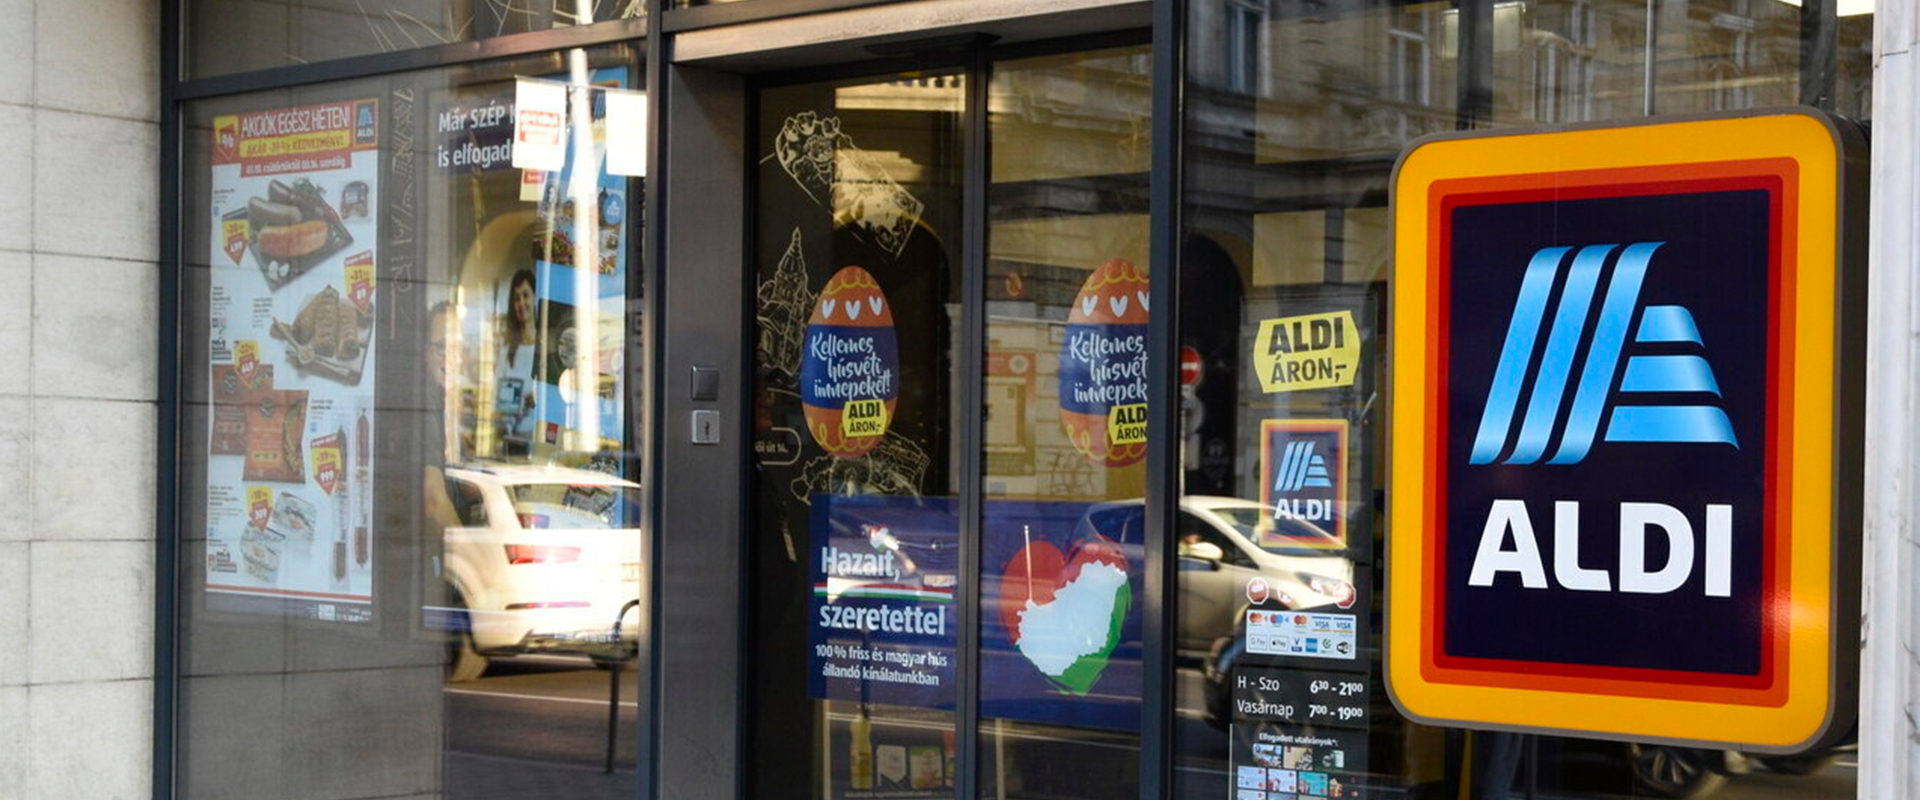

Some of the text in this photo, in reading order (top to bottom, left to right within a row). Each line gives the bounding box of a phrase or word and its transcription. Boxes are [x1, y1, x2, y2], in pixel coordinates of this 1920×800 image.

[241, 104, 349, 137] AKCIÓK EGÉSZ HÉTEN!
[439, 107, 466, 132] Már
[470, 100, 504, 128] SZÉP
[438, 139, 514, 168] is elfogad
[811, 332, 874, 360] Kellemes
[1069, 331, 1143, 362] Kellemes
[1268, 317, 1344, 355] ALDI
[827, 351, 882, 382] húsvéti
[814, 368, 891, 401] ünnepeket!
[848, 402, 880, 419] ALDI
[1274, 498, 1331, 521] ALDI
[1468, 498, 1733, 597] ALDI
[821, 547, 900, 583] Hazait,
[820, 604, 945, 635] szeretettel
[1315, 621, 1330, 630] VISA
[1336, 622, 1351, 630] VISA
[849, 645, 870, 660] friss
[872, 647, 884, 662] és
[885, 651, 925, 668] magyar
[927, 650, 947, 666] hús
[822, 663, 940, 687] állandó kínálatunkban
[1238, 676, 1247, 689] H
[1259, 677, 1280, 691] Szo
[1237, 699, 1294, 719] Vasárnap
[1259, 733, 1293, 743] Elfogadott
